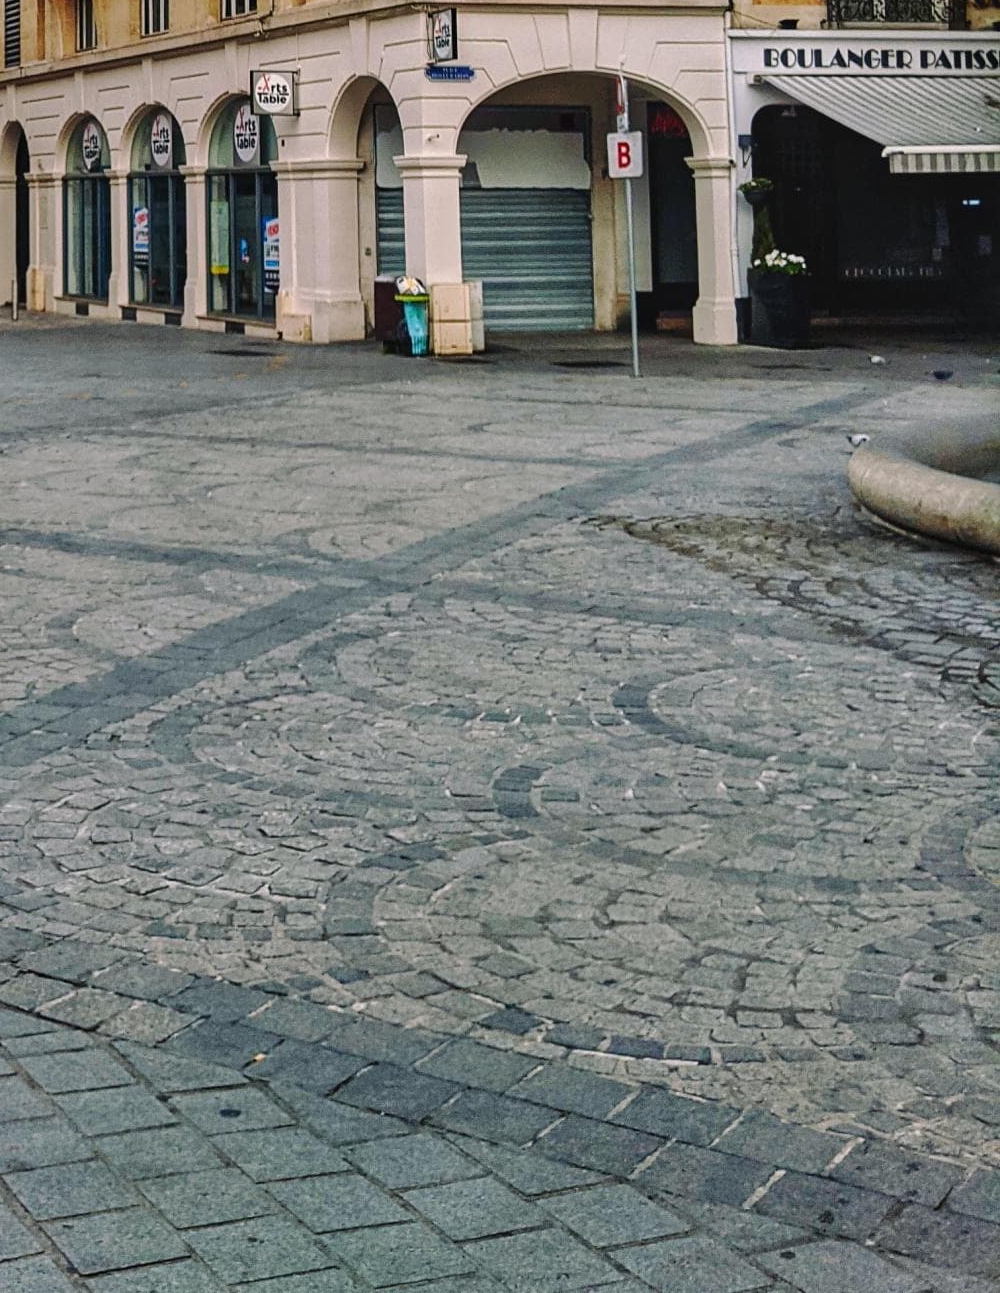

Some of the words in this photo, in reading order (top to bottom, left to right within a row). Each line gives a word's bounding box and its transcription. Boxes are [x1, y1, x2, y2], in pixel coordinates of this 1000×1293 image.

[763, 49, 912, 69] BOULANGER
[920, 49, 1000, 69] PATISS
[257, 92, 289, 104] Table
[153, 140, 169, 154] Table
[236, 132, 257, 149] Table
[617, 142, 631, 169] B
